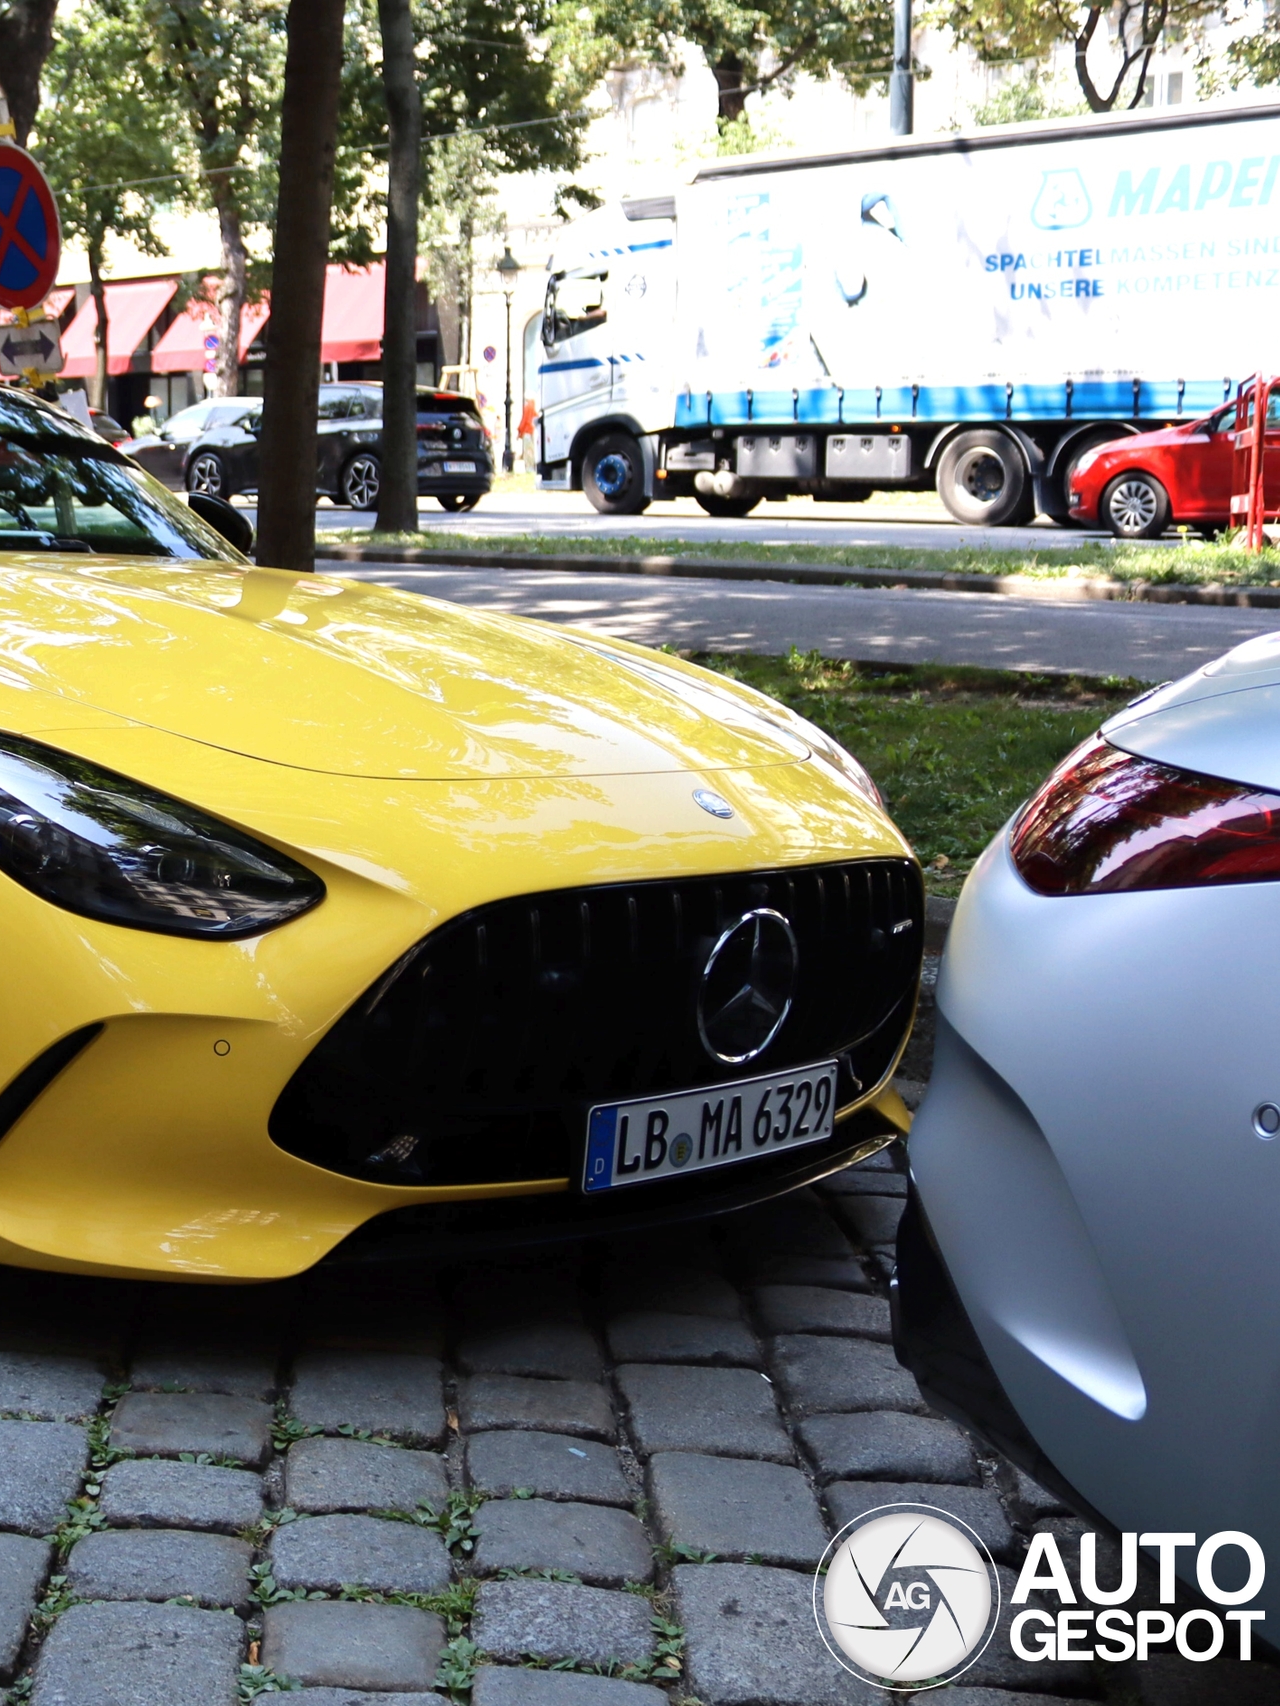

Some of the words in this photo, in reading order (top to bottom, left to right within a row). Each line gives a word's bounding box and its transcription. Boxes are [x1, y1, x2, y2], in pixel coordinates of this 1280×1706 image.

[1107, 154, 1280, 218] MAPEI
[984, 240, 1216, 273] SPACHTELMASSEN
[1009, 277, 1105, 301] UNSERE
[1116, 268, 1280, 295] KOMPETENZ
[617, 1108, 670, 1176] LB
[698, 1094, 743, 1160] MA
[753, 1075, 832, 1146] 6329
[594, 1157, 605, 1175] D
